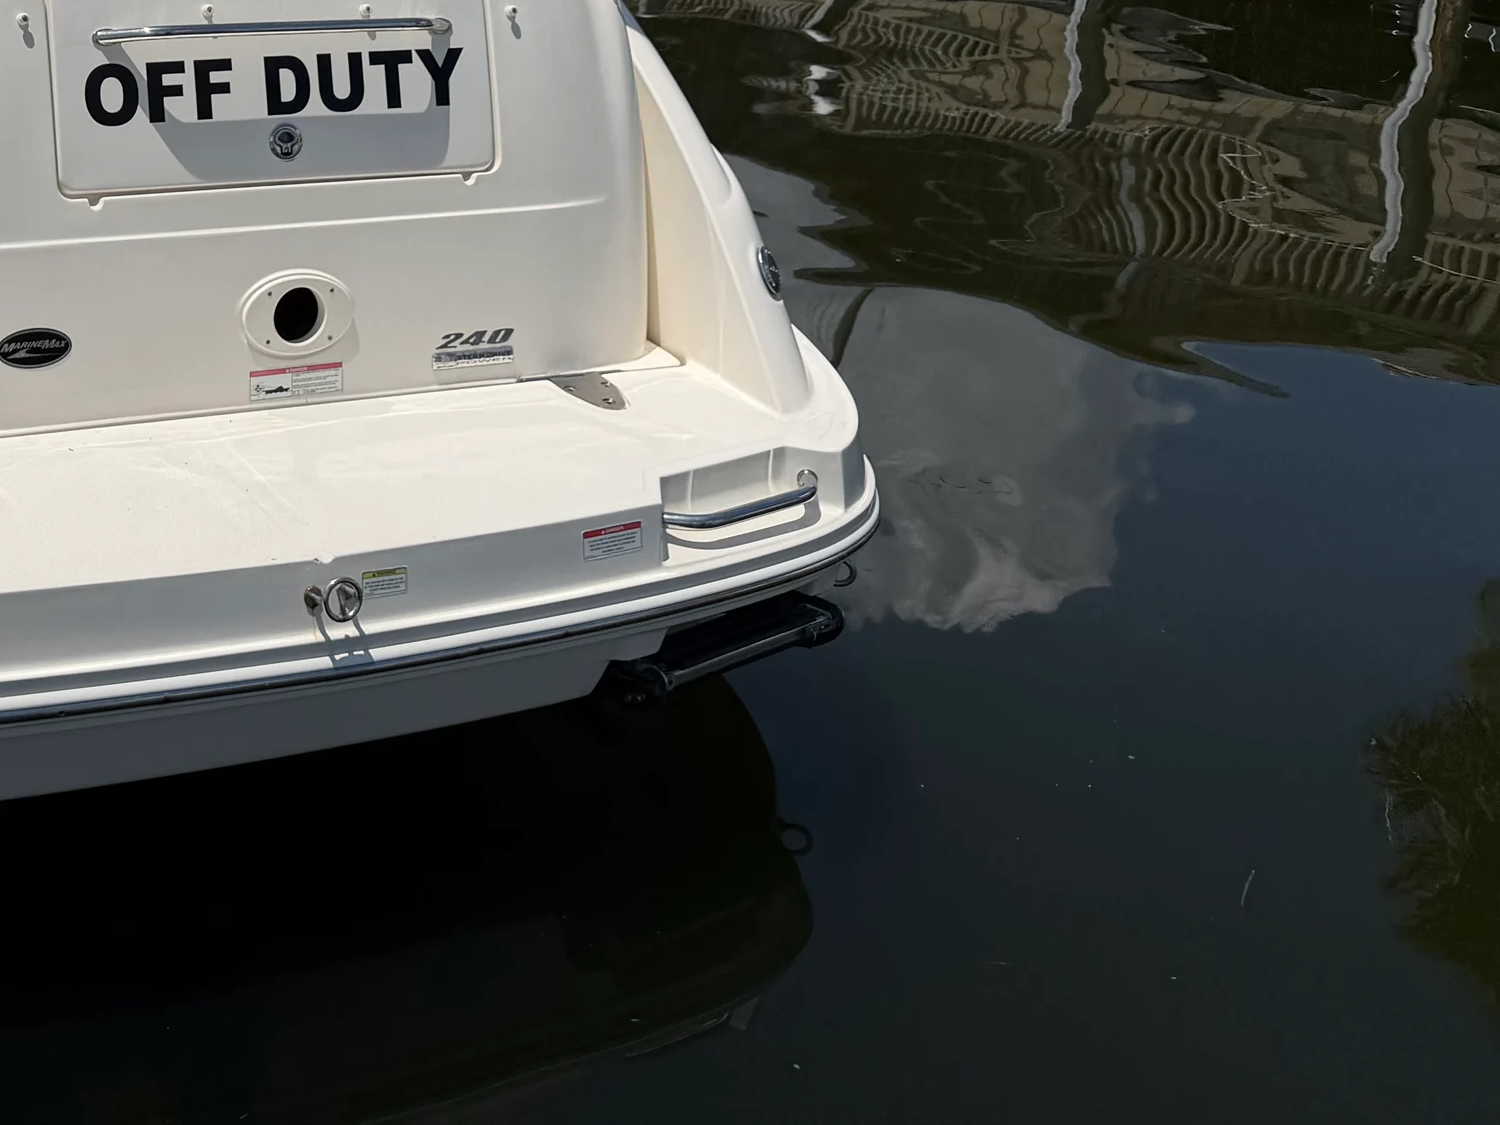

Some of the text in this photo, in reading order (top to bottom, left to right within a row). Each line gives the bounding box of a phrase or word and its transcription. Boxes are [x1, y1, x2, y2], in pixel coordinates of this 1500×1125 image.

[84, 47, 463, 127] OFF DUTY
[435, 328, 514, 350] 240
